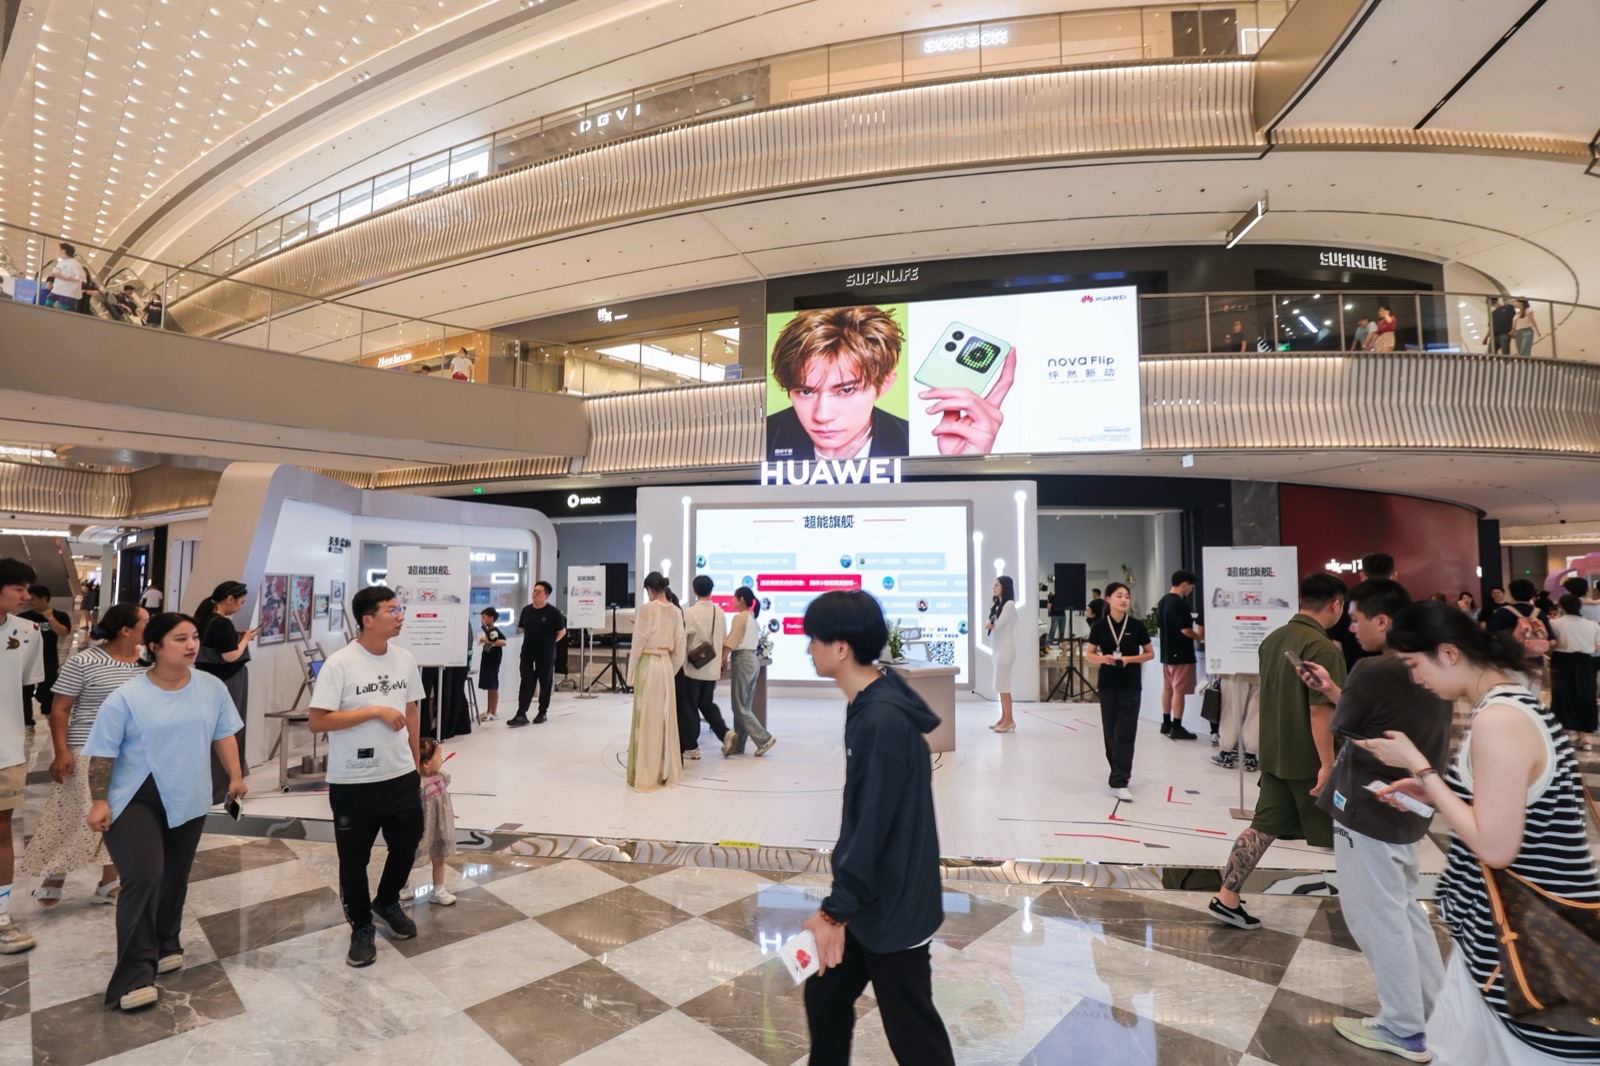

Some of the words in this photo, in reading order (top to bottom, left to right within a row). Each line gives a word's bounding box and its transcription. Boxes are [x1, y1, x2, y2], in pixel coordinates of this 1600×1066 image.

[846, 267, 919, 287] SUPINLIFE
[1095, 294, 1127, 302] HUAWEI
[1047, 356, 1087, 367] nova
[1090, 355, 1115, 366] Flip
[1048, 368, 1115, 380] 怦然新动
[761, 458, 902, 486] HUAWEI
[804, 514, 854, 529] 超能旗舰
[407, 565, 449, 576] 超能旗舰
[1227, 566, 1273, 578] 超能旗舰
